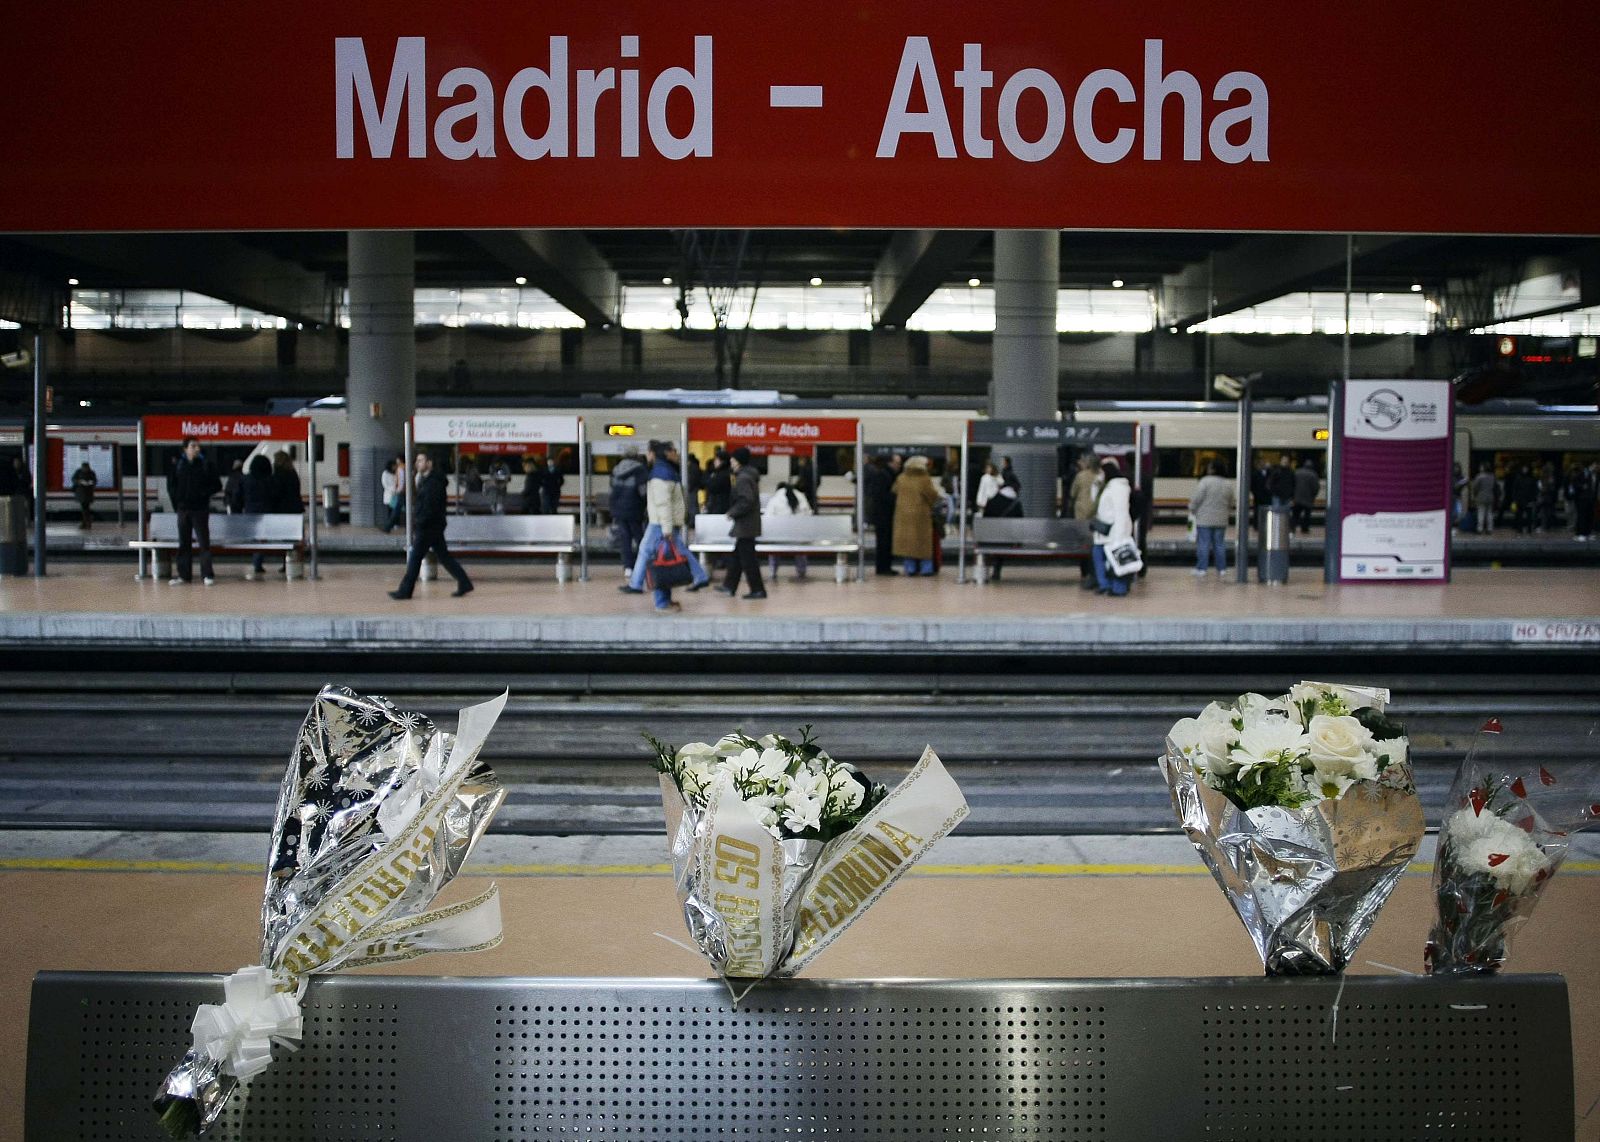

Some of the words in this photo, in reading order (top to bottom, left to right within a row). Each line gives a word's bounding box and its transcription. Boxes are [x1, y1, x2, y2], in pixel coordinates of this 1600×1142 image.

[335, 35, 712, 160] Madrid
[770, 85, 823, 107] -
[876, 36, 1270, 163] Atocha
[181, 420, 219, 436] Madrid
[232, 420, 271, 436] Atocha
[466, 420, 516, 430] Guadalajara
[726, 422, 766, 437] Madrid
[778, 423, 820, 437] Atocha
[495, 430, 505, 438] de
[508, 430, 543, 438] Henares
[1516, 624, 1537, 638] NO
